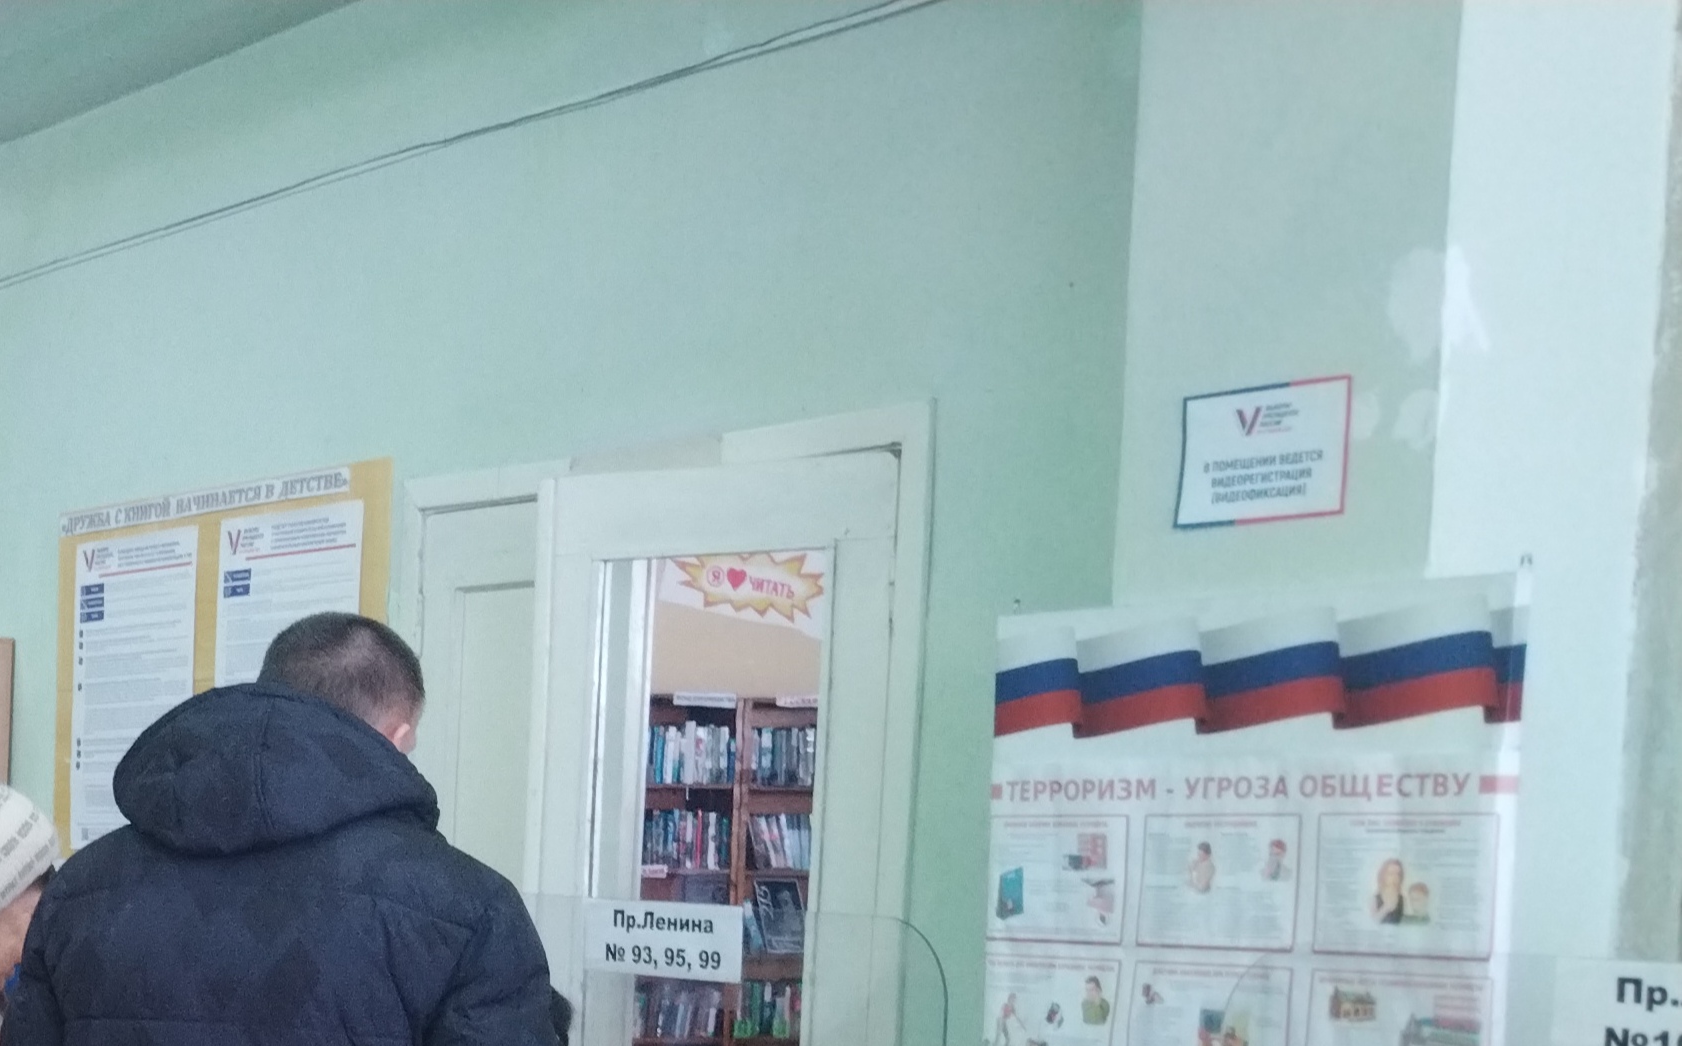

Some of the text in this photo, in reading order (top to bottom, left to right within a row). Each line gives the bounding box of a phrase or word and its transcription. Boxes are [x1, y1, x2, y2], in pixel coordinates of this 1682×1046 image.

[1212, 455, 1277, 472] ПОМЕЩЕНИИ
[1278, 449, 1324, 465] ВЕДЕТСЯ
[1211, 467, 1312, 489] ВИДЕОРЕГИСТРАЦИЯ
[114, 508, 122, 524] С
[123, 498, 171, 523] КНИГОЙ
[175, 485, 261, 515] НАЧИНАЕТСЯ
[264, 483, 275, 499] В
[749, 575, 796, 599] ЧИТАТЬ
[1005, 778, 1158, 802] ТЕРРОРИЗМ
[1184, 775, 1290, 801] УГРОЗА
[1299, 773, 1473, 802] ОБЩЕСТВУ
[613, 909, 714, 934] Пр.Ленина
[605, 943, 722, 972] № 93, 95, 99
[1616, 976, 1682, 1012] Пр.
